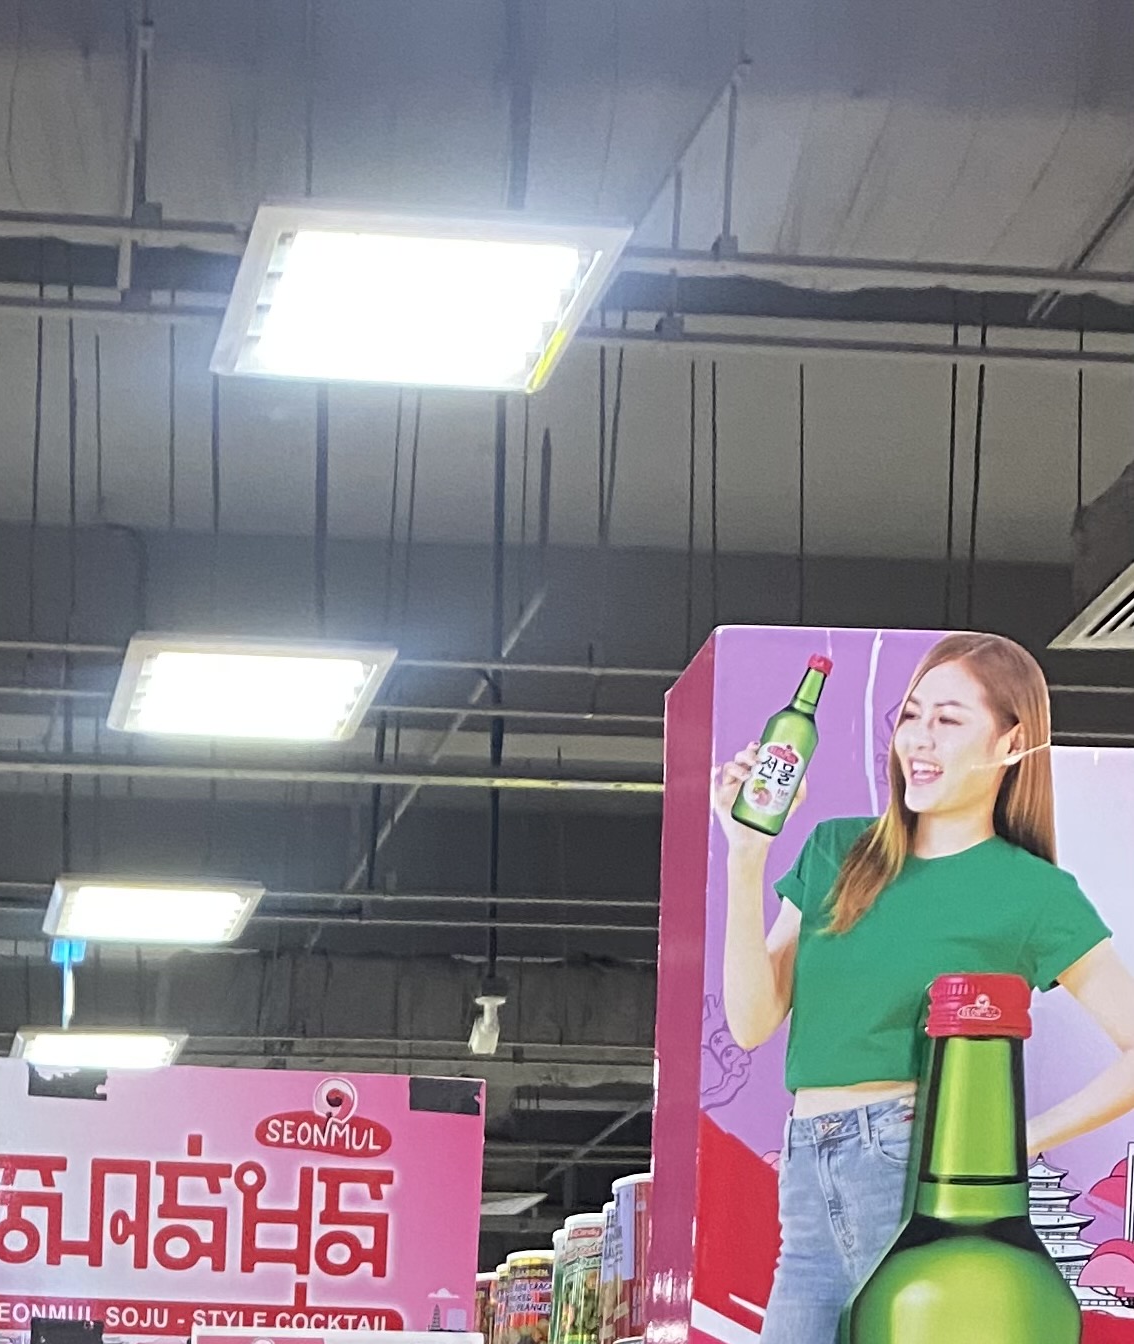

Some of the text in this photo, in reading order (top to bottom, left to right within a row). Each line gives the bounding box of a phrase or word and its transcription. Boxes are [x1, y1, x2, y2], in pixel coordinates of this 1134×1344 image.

[265, 1117, 382, 1152] SEONMUL
[105, 1306, 169, 1329] SOJU
[192, 1309, 271, 1329] STYLE
